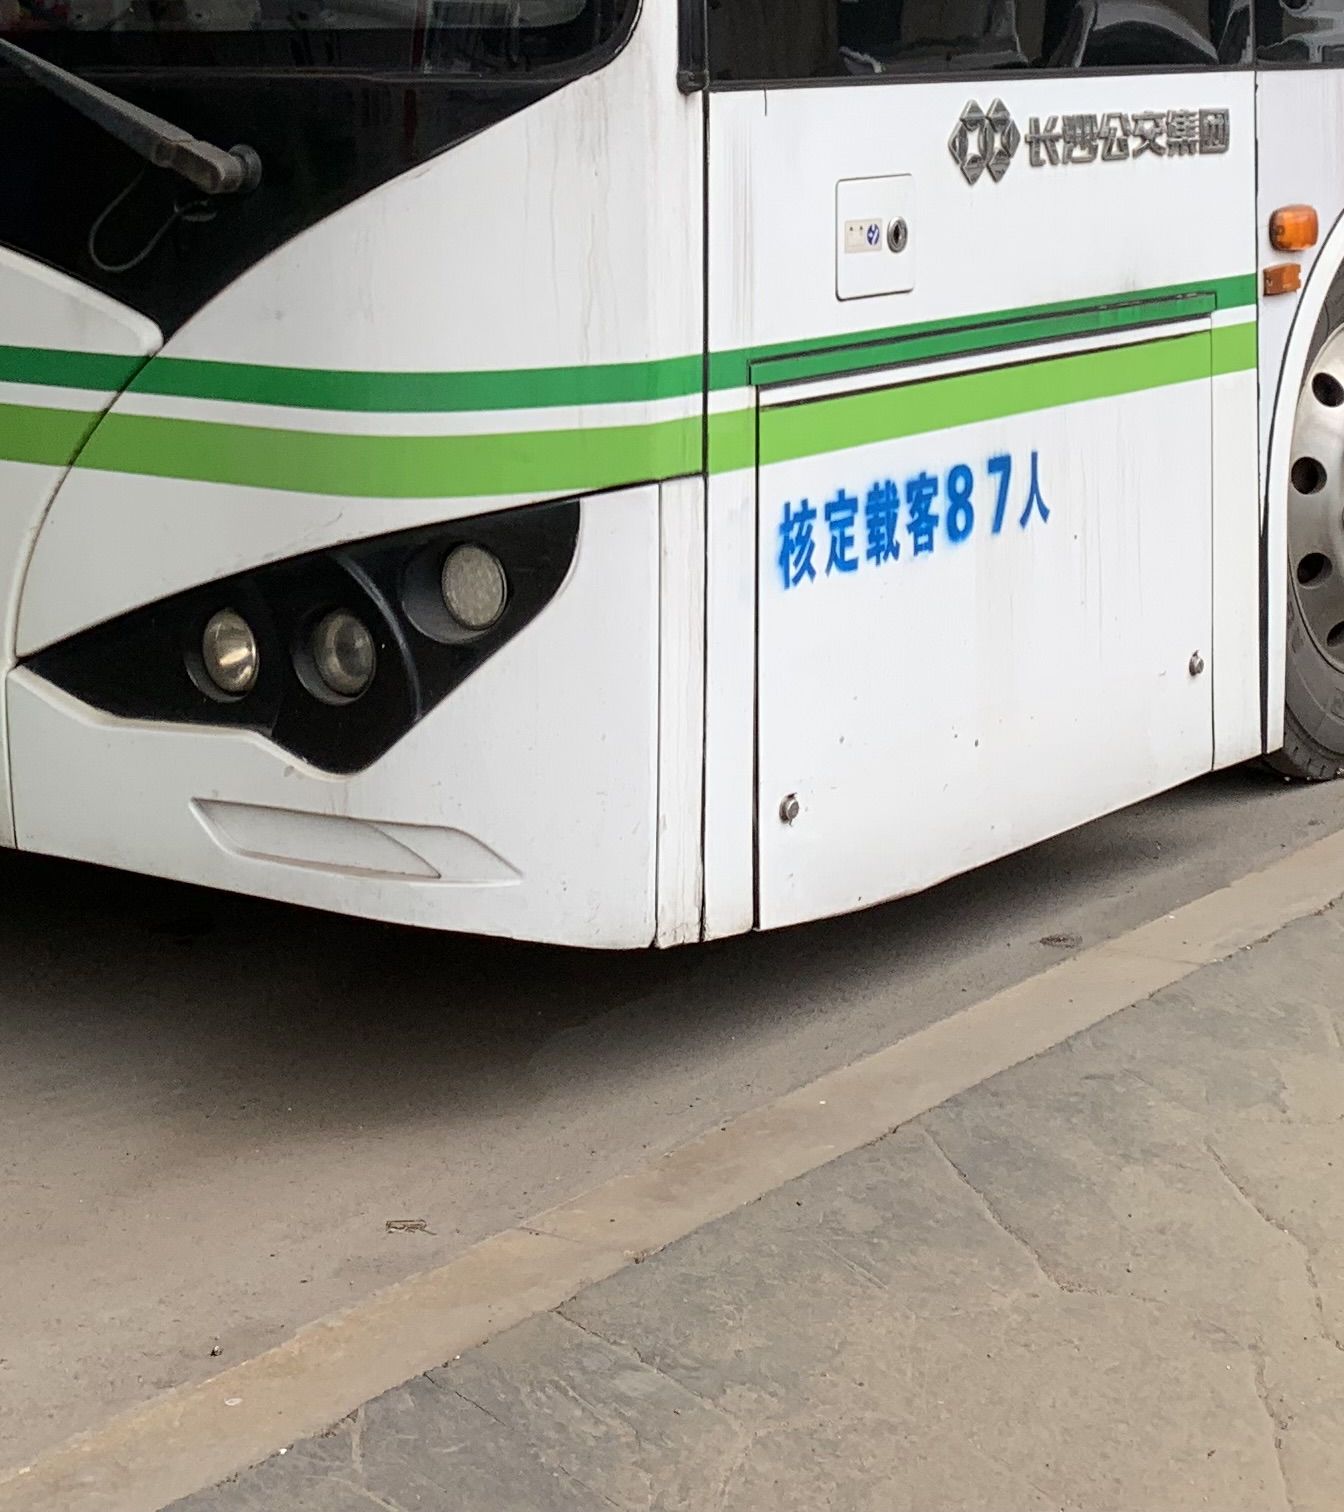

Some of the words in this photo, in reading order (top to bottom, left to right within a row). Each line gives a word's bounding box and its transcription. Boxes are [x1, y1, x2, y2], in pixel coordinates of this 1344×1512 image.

[1024, 108, 1230, 167] 长沙公交集团
[777, 451, 1050, 590] 核定载客87人
